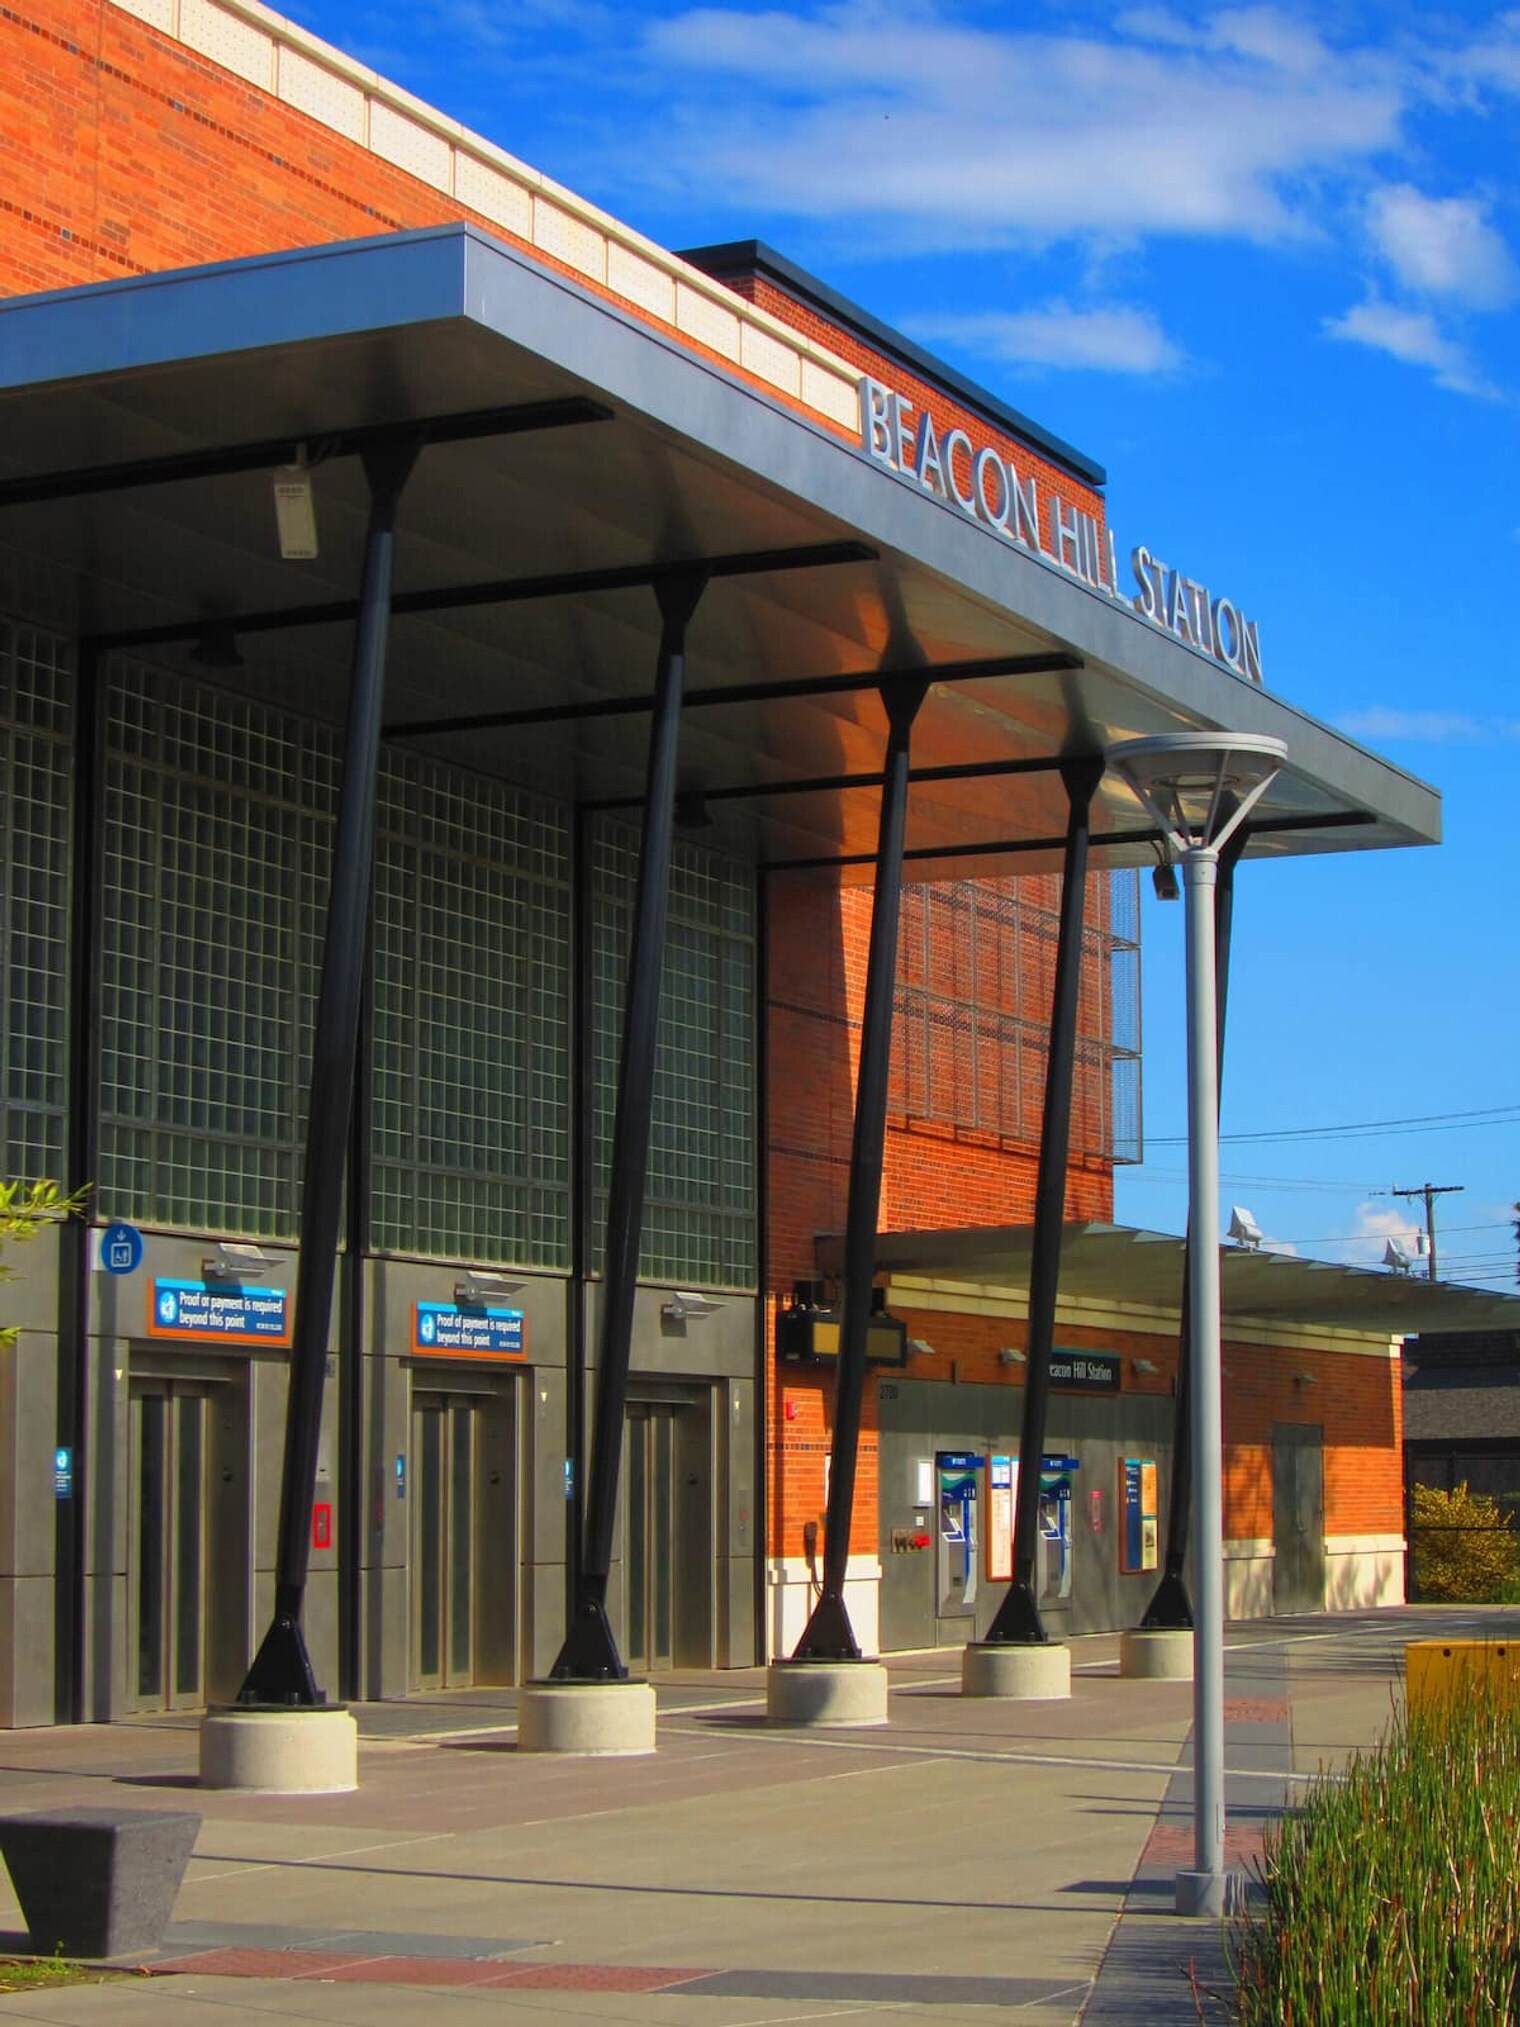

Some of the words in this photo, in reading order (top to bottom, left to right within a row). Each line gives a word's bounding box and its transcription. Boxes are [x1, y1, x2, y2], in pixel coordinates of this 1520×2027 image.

[859, 376, 1041, 553] BEACON
[1049, 495, 1127, 605] HILL
[1132, 545, 1263, 685] STATION
[179, 1291, 200, 1307] Proof
[211, 1297, 243, 1312] payment
[244, 1297, 251, 1311] is
[252, 1298, 282, 1316] required
[179, 1309, 208, 1328] beyond
[209, 1312, 223, 1327] this
[225, 1313, 245, 1331] point
[1049, 1364, 1071, 1378] eacon
[1073, 1361, 1086, 1379] Hill
[1088, 1361, 1112, 1381] Station
